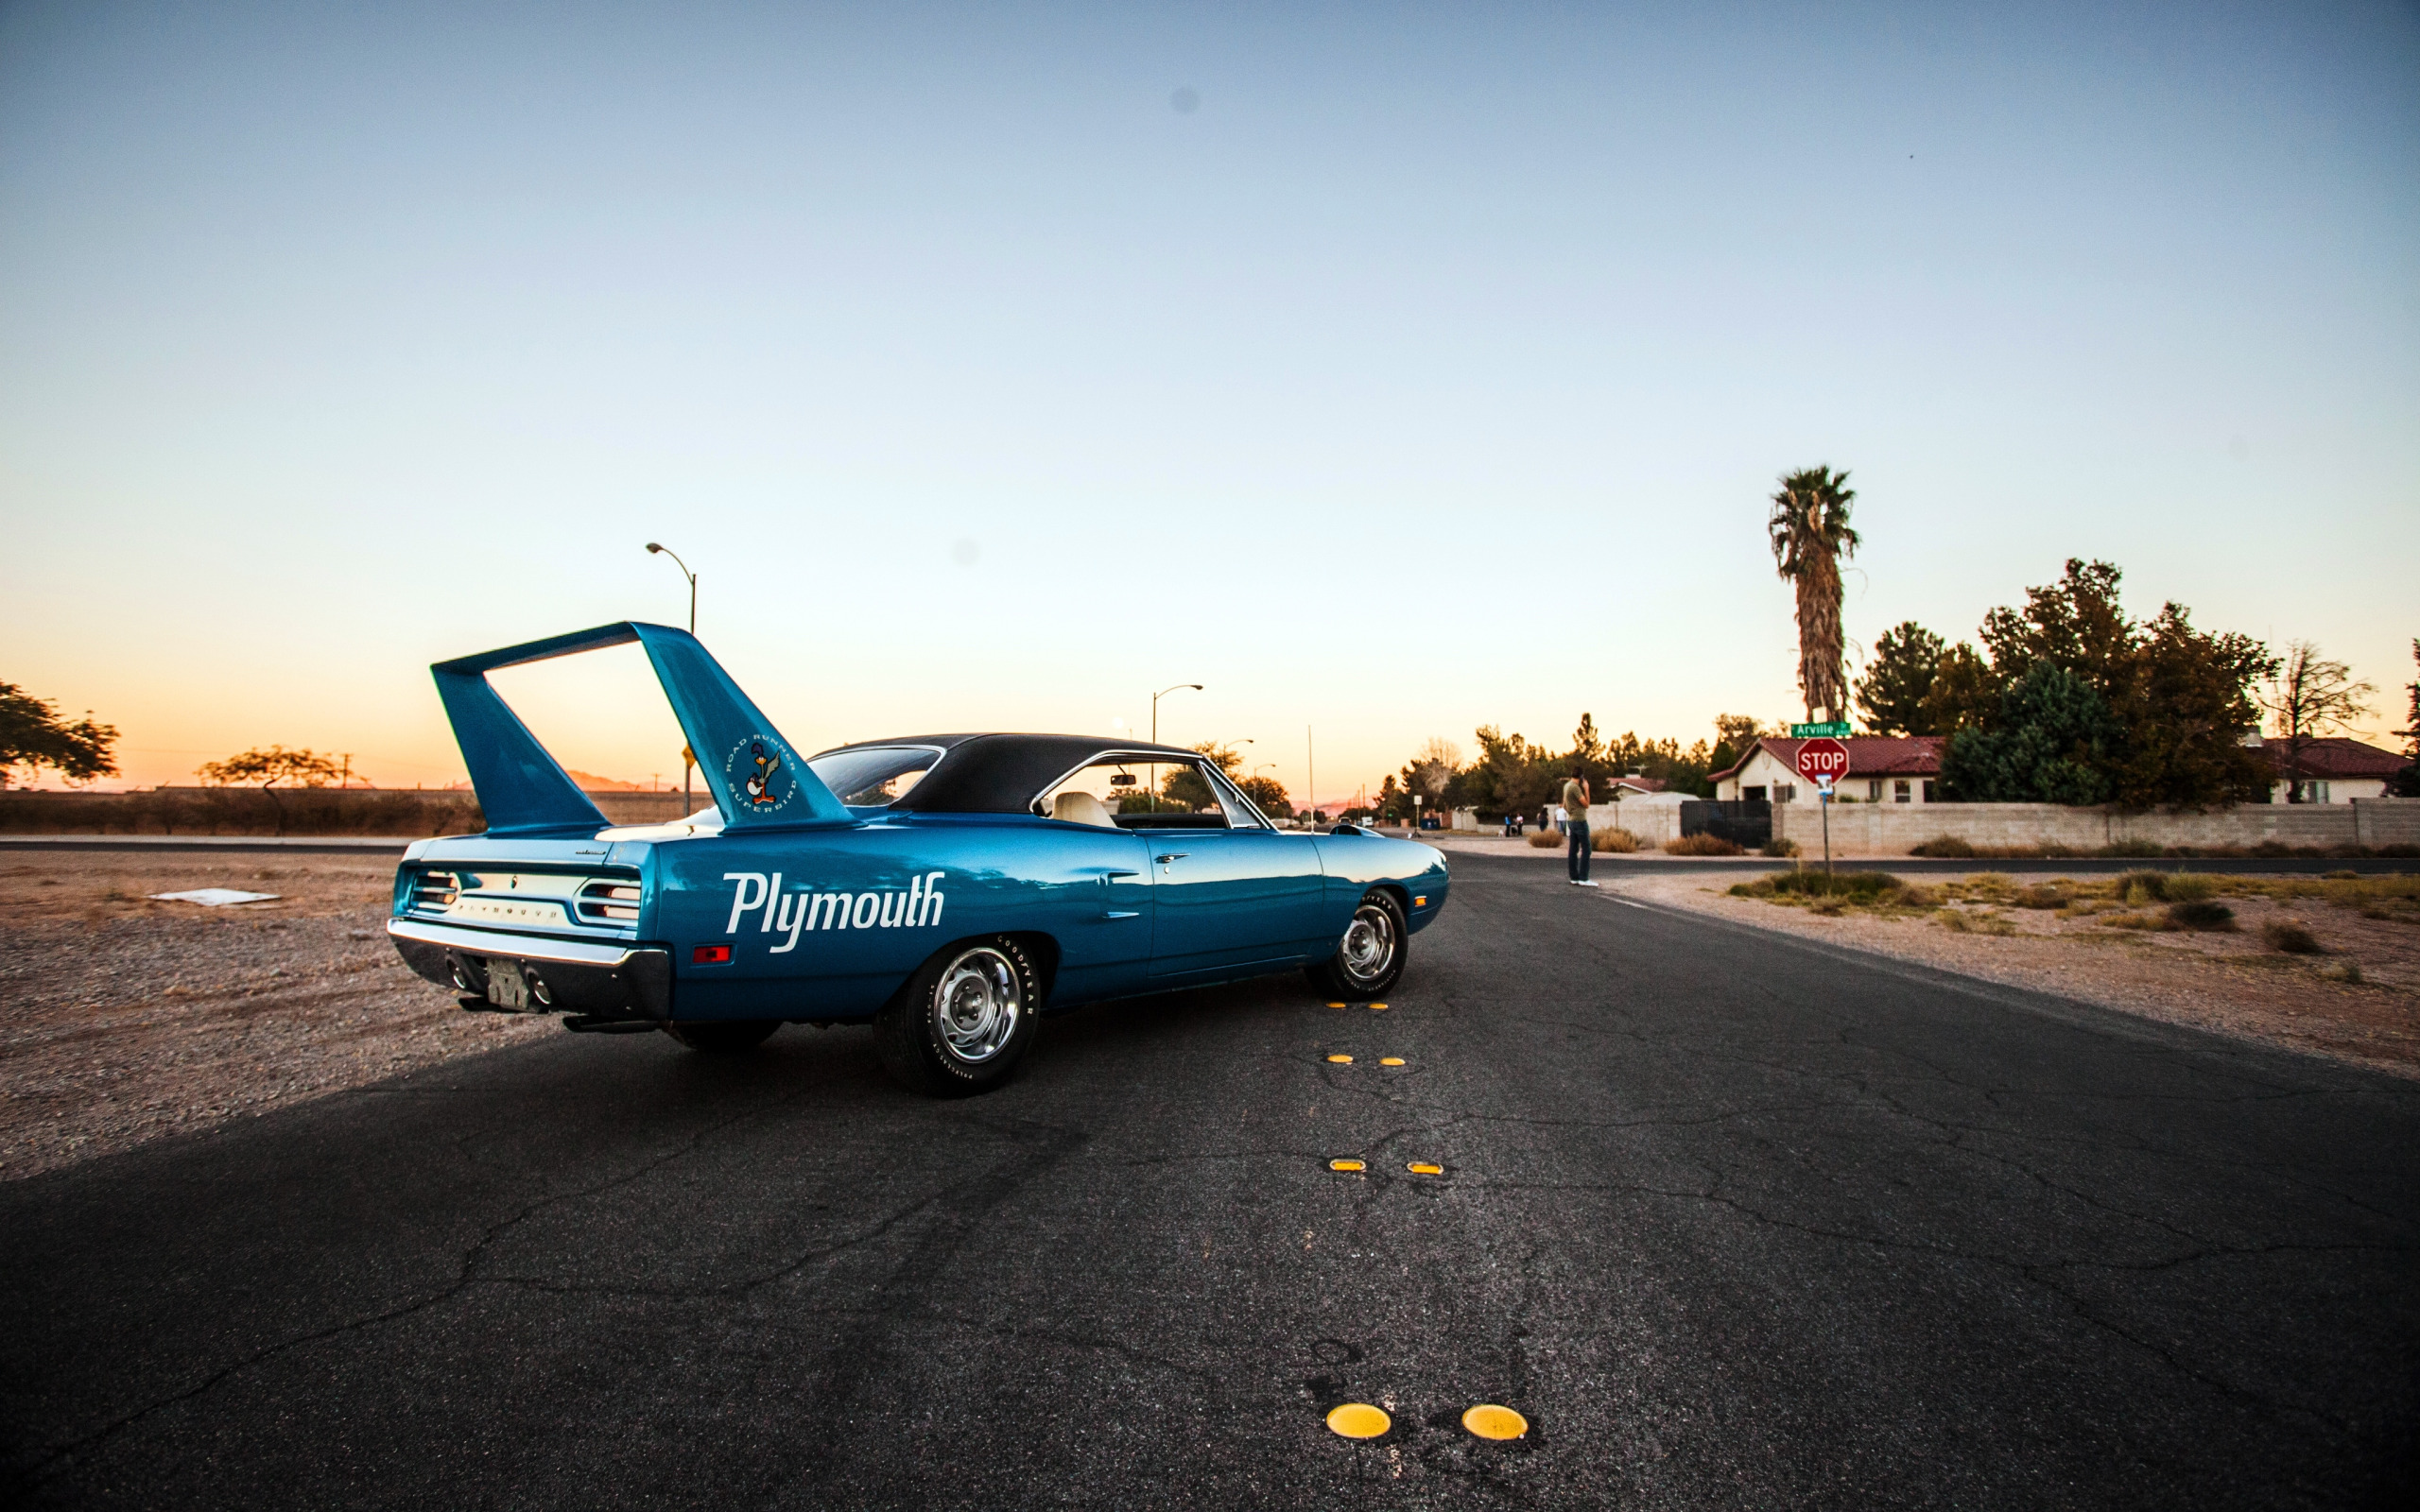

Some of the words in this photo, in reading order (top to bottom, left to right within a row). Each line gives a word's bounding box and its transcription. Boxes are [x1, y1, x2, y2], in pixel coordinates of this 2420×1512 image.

[1797, 724, 1834, 734] Arville
[726, 738, 747, 772] ROAD
[753, 734, 796, 771] RUNNER
[1801, 752, 1844, 771] STOP
[729, 781, 797, 813] SUPERBIRD
[722, 871, 945, 954] Plymouth
[997, 935, 1034, 1015] GOODYEAR
